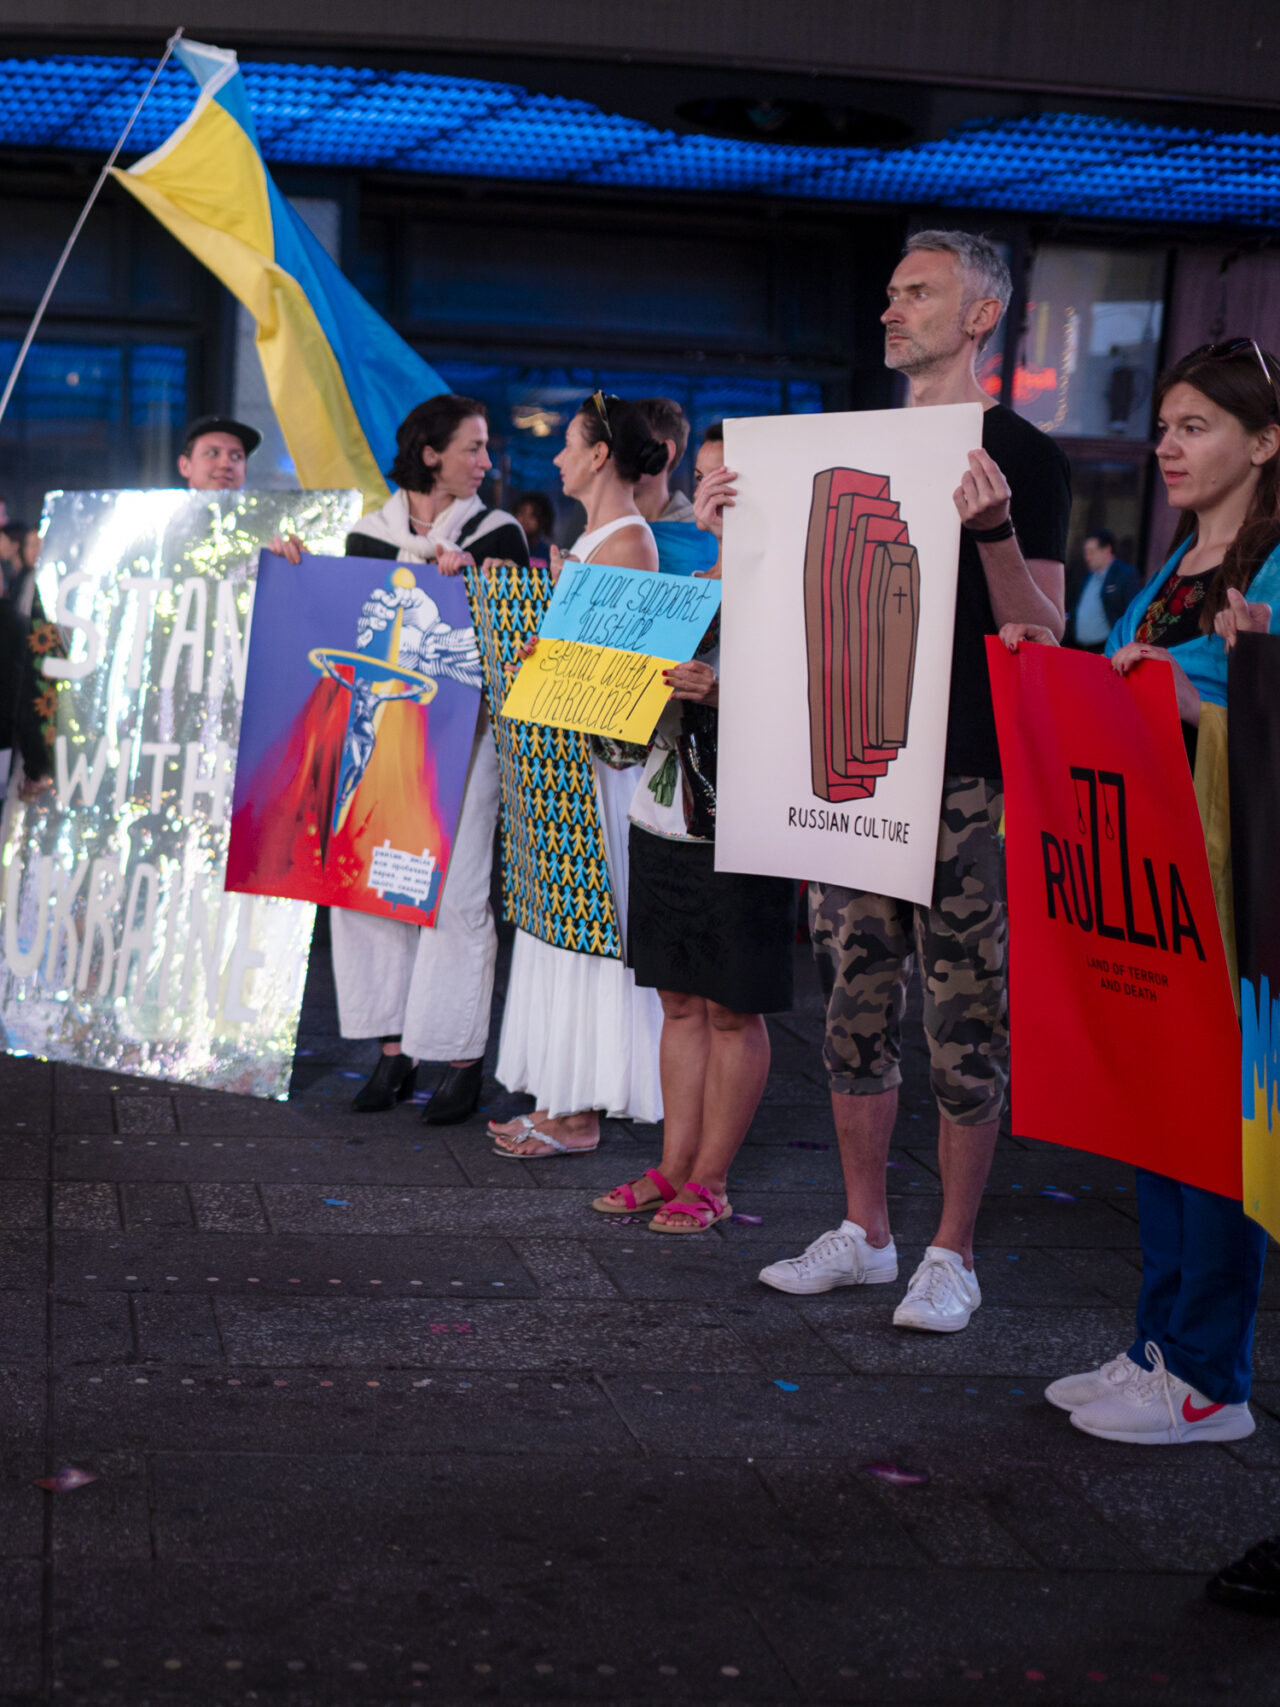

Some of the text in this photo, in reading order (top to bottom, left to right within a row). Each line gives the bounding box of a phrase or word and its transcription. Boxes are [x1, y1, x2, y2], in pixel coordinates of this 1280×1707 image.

[42, 571, 258, 701] STAN
[56, 736, 230, 826] WITH
[788, 806, 911, 844] RUSSIAN CULTURE
[4, 852, 266, 1023] UKRAINE
[1086, 953, 1169, 988] LAND OF TERROR
[1100, 977, 1158, 1003] AND DEATH
